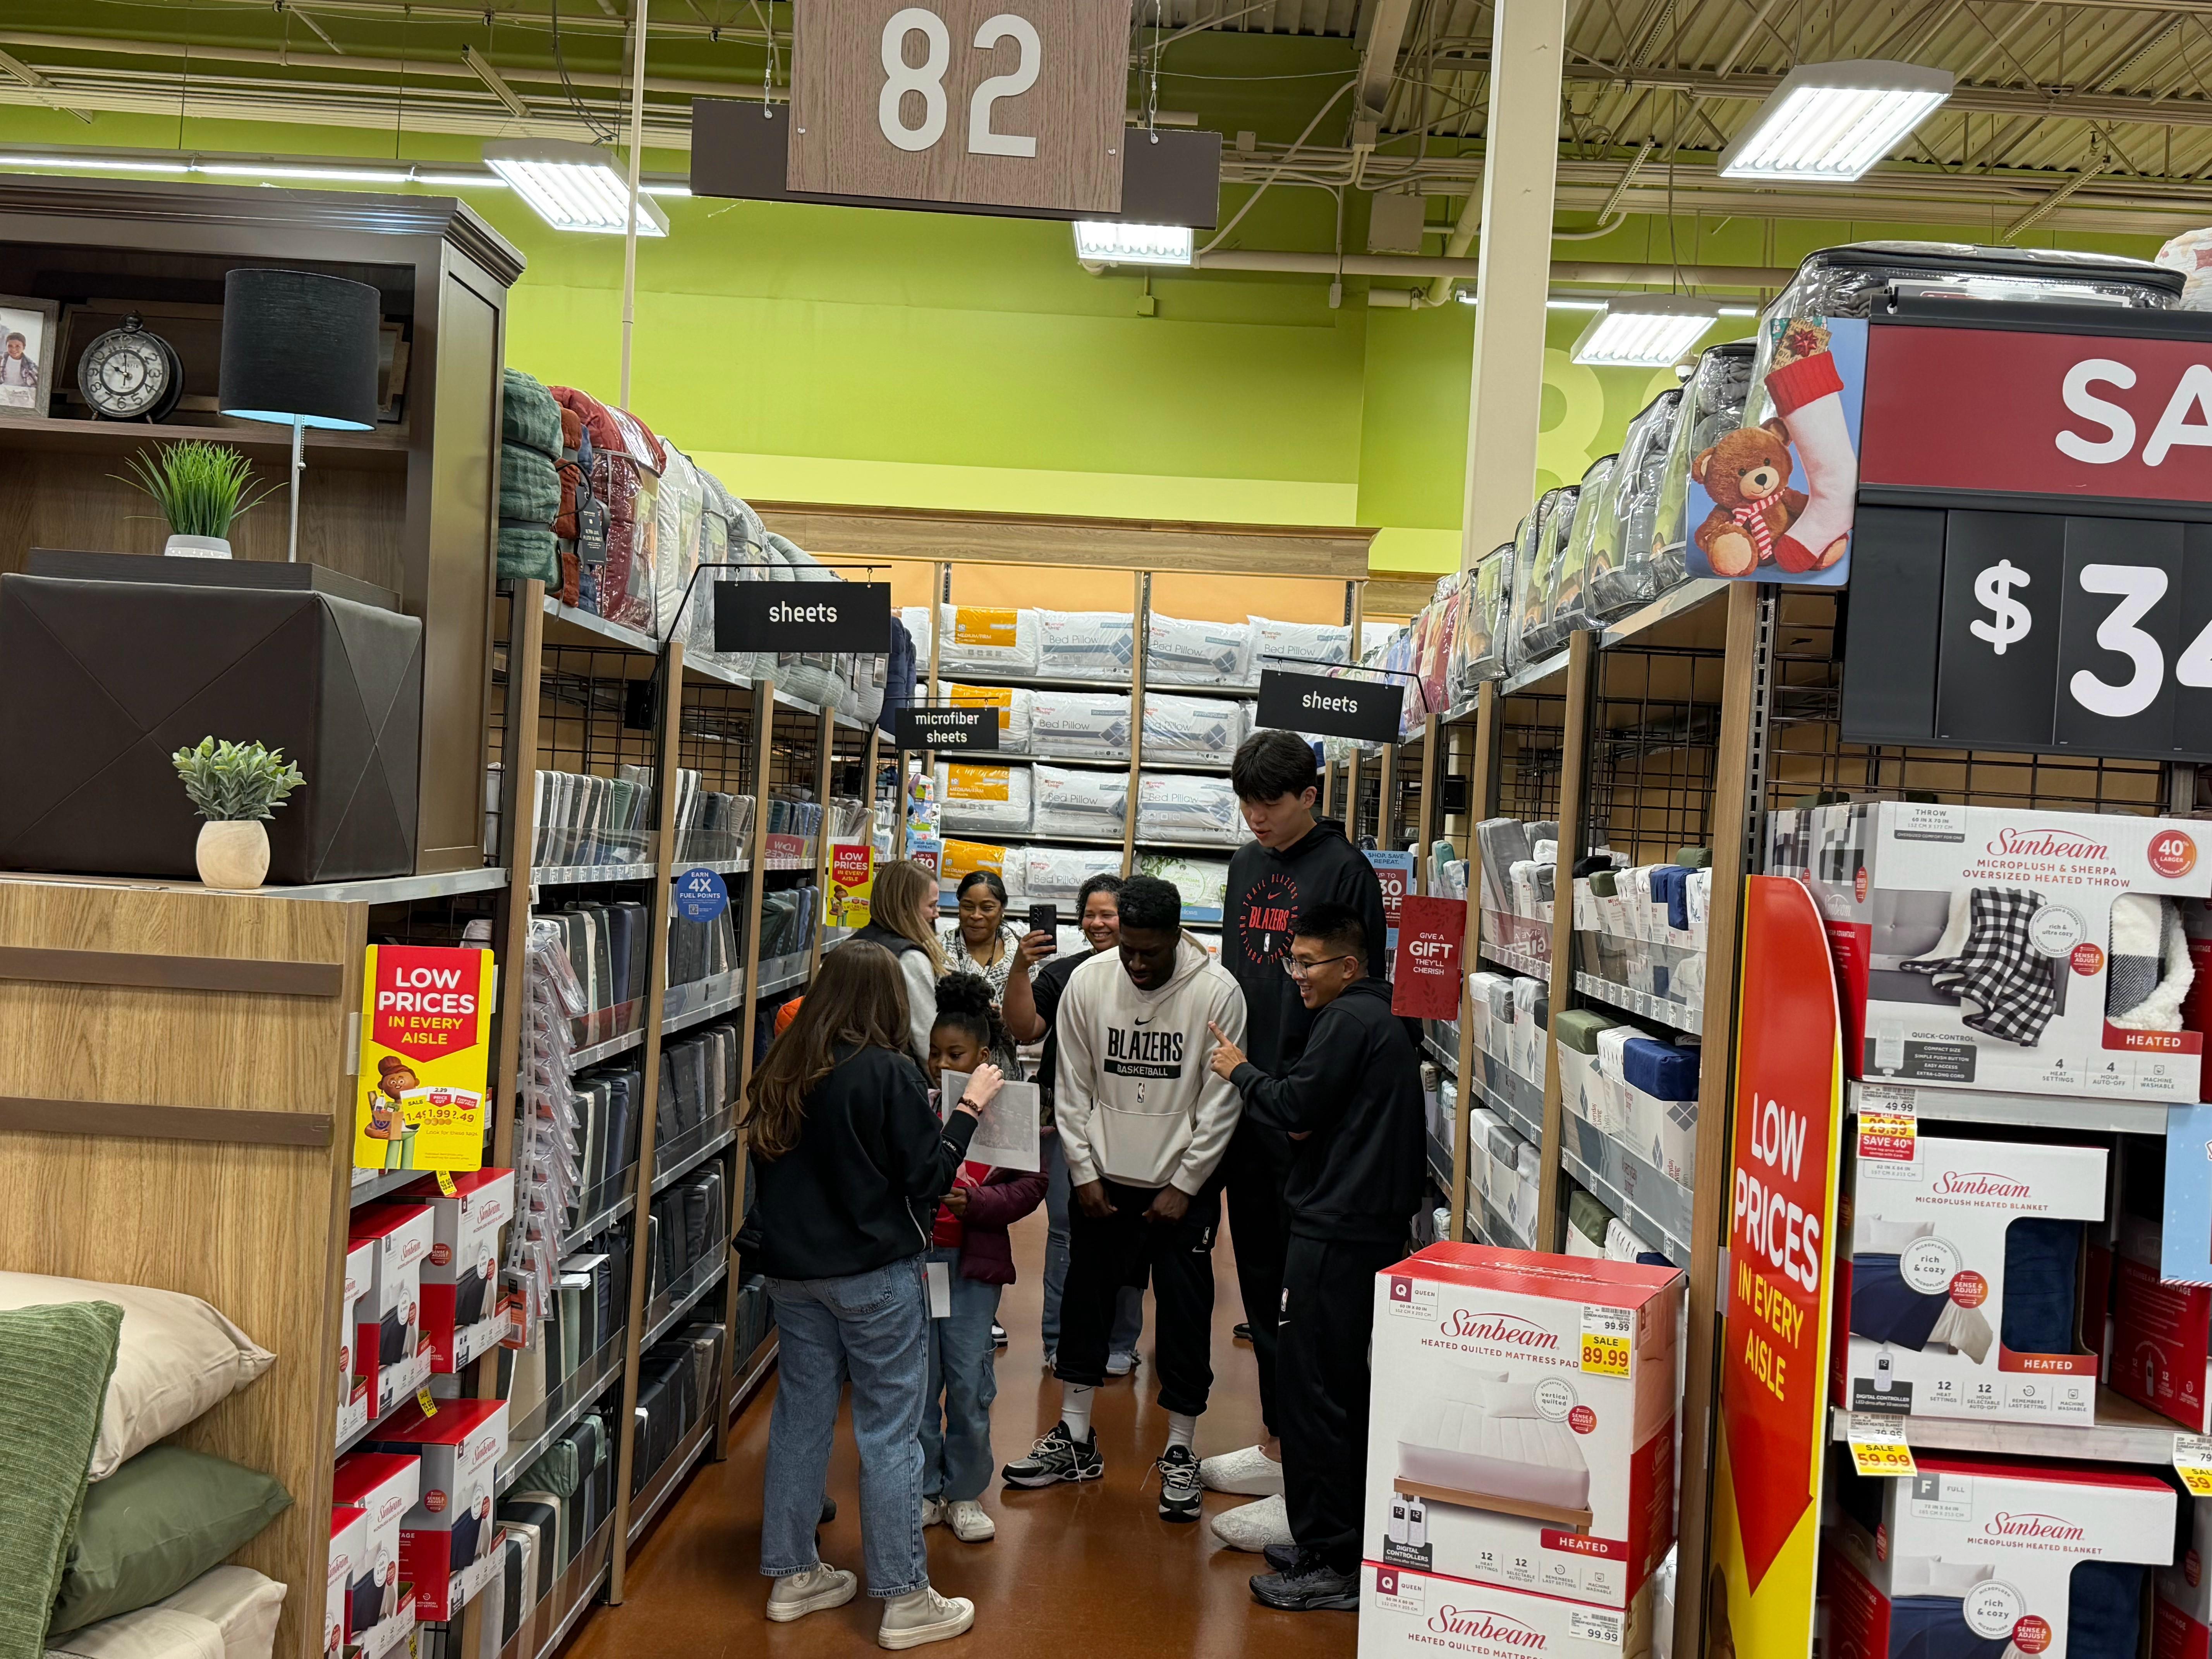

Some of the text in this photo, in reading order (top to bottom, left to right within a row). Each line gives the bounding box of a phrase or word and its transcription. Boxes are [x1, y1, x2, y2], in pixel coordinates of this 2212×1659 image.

[879, 8, 1041, 157] 82
[90, 382, 101, 393] 8
[144, 383, 157, 393] 4
[117, 396, 126, 409] 6
[131, 393, 143, 405] 5
[769, 601, 837, 623] sheets
[1050, 635, 1099, 644] Bed Pillow
[1153, 641, 1202, 656] Bed Pillow
[1265, 644, 1315, 656] Bed Pillow
[1302, 691, 1358, 713] sheets
[916, 712, 979, 725] microfiber
[1040, 720, 1090, 730] Bed Pillow
[927, 730, 967, 743] sheets
[1048, 793, 1098, 805] Bed Pillow
[1987, 828, 2107, 860] Sunbeam
[840, 852, 863, 860] LOW
[834, 861, 868, 870] PRICES
[1977, 859, 2055, 872] MICROPLUSH
[2071, 866, 2116, 875] SHERPA
[689, 878, 711, 892] 4X
[1963, 870, 2130, 887] OVERSIZED HEATED THROW
[1243, 874, 1298, 906] TRAIL BLAZERS
[1249, 906, 1290, 931] BLAZERS
[1409, 941, 1453, 958] GIFT
[1415, 958, 1444, 967] THEY'LL
[1413, 967, 1444, 975] CHERISH
[395, 967, 461, 989] LOW
[379, 991, 475, 1014] PRICES
[388, 1016, 463, 1029] IN EVERY
[402, 1032, 448, 1045] AISLE
[1107, 1026, 1183, 1061] BLAZERS
[1912, 1032, 1975, 1042] QUICK-CONTROL
[2126, 1035, 2181, 1047] HEATED
[1117, 1064, 1168, 1076] BASKETBALL
[2055, 1059, 2064, 1068] 4
[2107, 1062, 2115, 1072] 4
[429, 1109, 450, 1118] 1.99
[1885, 1102, 1913, 1112] 49.99
[1752, 1092, 1807, 1183] LOW
[1863, 1135, 1912, 1148] SAVE 40%
[1933, 1171, 2030, 1198] Sunbeam
[1916, 1196, 1971, 1206] MICROPLUSH
[1734, 1167, 1820, 1293] PRICES
[1915, 1243, 1947, 1254] MICROPLUSH
[1396, 1284, 1407, 1297] Q
[1738, 1259, 1803, 1349] IN EVERY
[1441, 1309, 1558, 1349] Sunbeam
[1605, 1322, 1629, 1331] 99.99
[1594, 1336, 1618, 1346] SALE
[1421, 1338, 1578, 1368] HEATED QUILTED MATTRESS PAD
[1583, 1346, 1628, 1367] 89.99
[1745, 1328, 1786, 1401] AISLE
[2024, 1359, 2073, 1370] HEATED
[1857, 1453, 1910, 1467] 59.99
[1921, 1480, 1932, 1493] F
[2186, 1476, 2211, 1488] 59
[1985, 1511, 2084, 1540] Sunbeam
[1396, 1545, 1419, 1554] DIGITAL
[1559, 1537, 1608, 1553] HEATED
[1967, 1537, 2102, 1554] MICROPLUSH HEATED BLANKET
[1386, 1549, 1428, 1562] CONTROLLERS
[1481, 1552, 1493, 1561] 12
[1382, 1577, 1393, 1590] Q
[1427, 1604, 1546, 1649] Sunbeam
[1588, 1628, 1618, 1642] 99.99
[1408, 1633, 1445, 1646] HEATED
[1448, 1642, 1489, 1654] QUILTED
